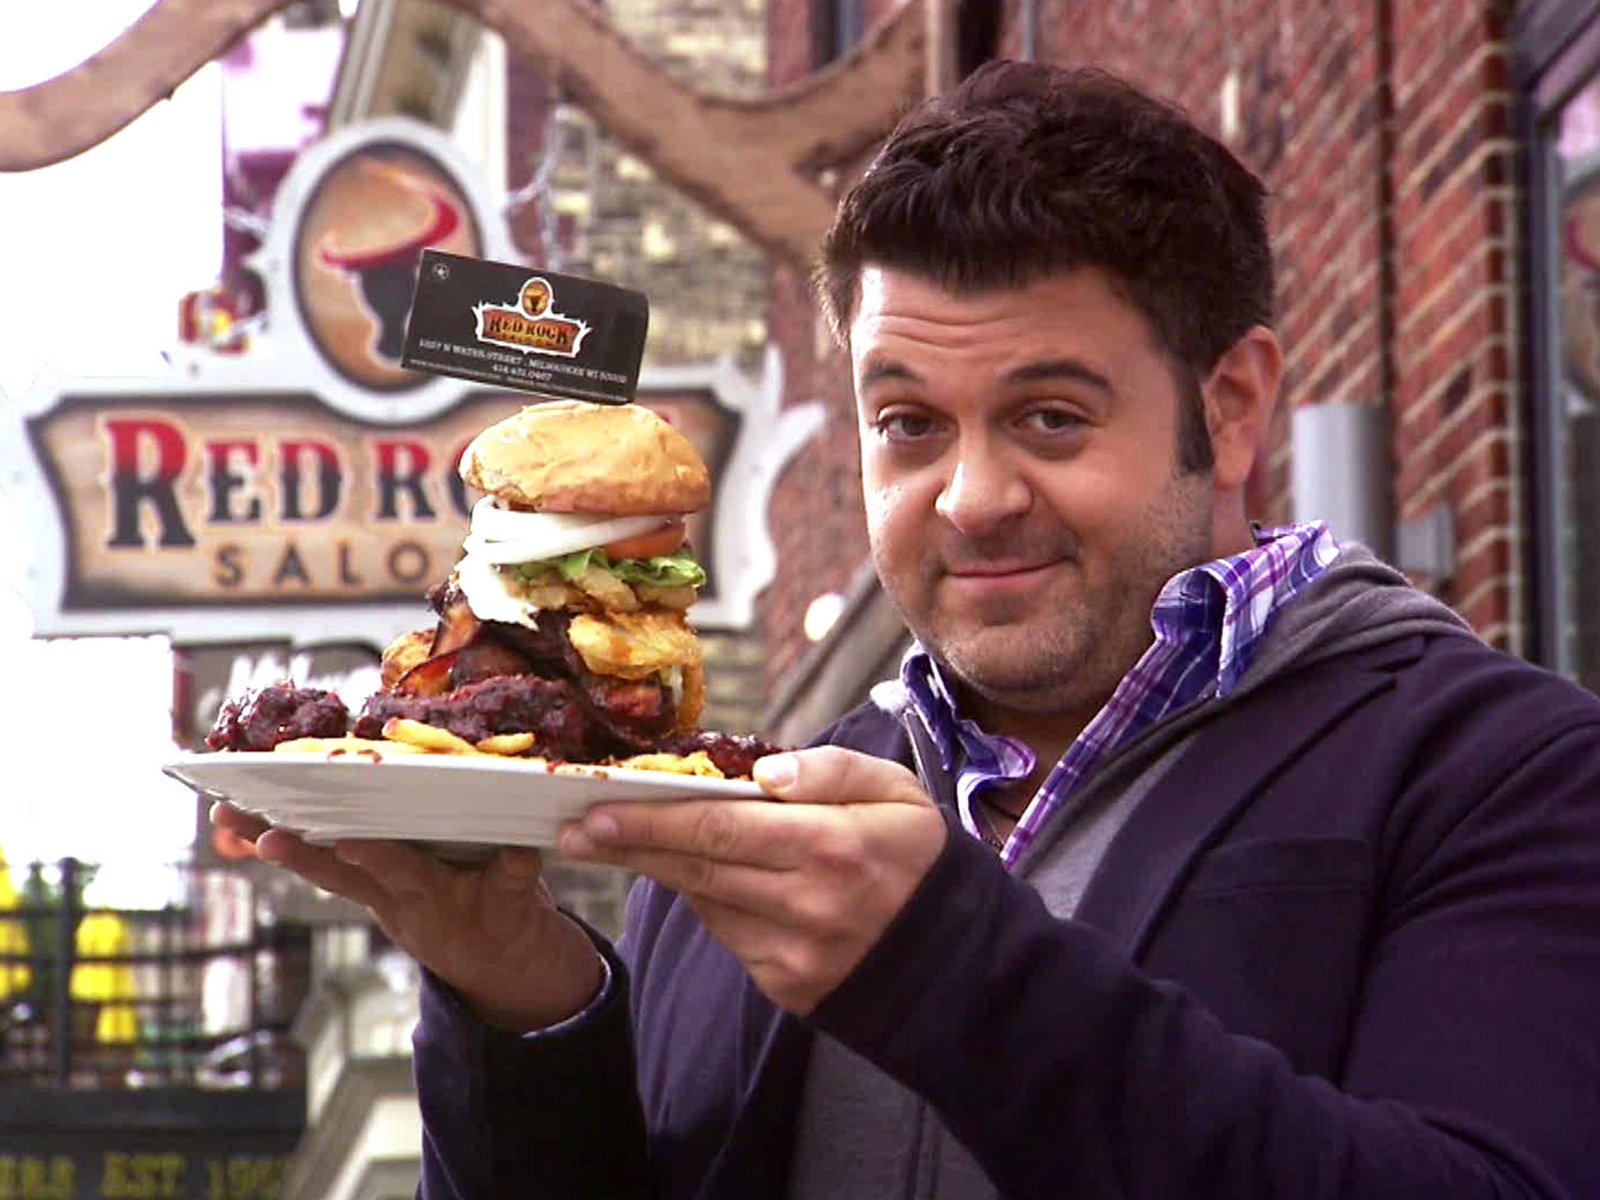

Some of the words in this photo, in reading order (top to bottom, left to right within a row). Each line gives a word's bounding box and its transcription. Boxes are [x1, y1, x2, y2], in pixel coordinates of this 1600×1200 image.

[489, 316, 523, 334] RED
[526, 323, 567, 345] ROCK
[104, 418, 344, 549] RED
[212, 541, 430, 586] SALO
